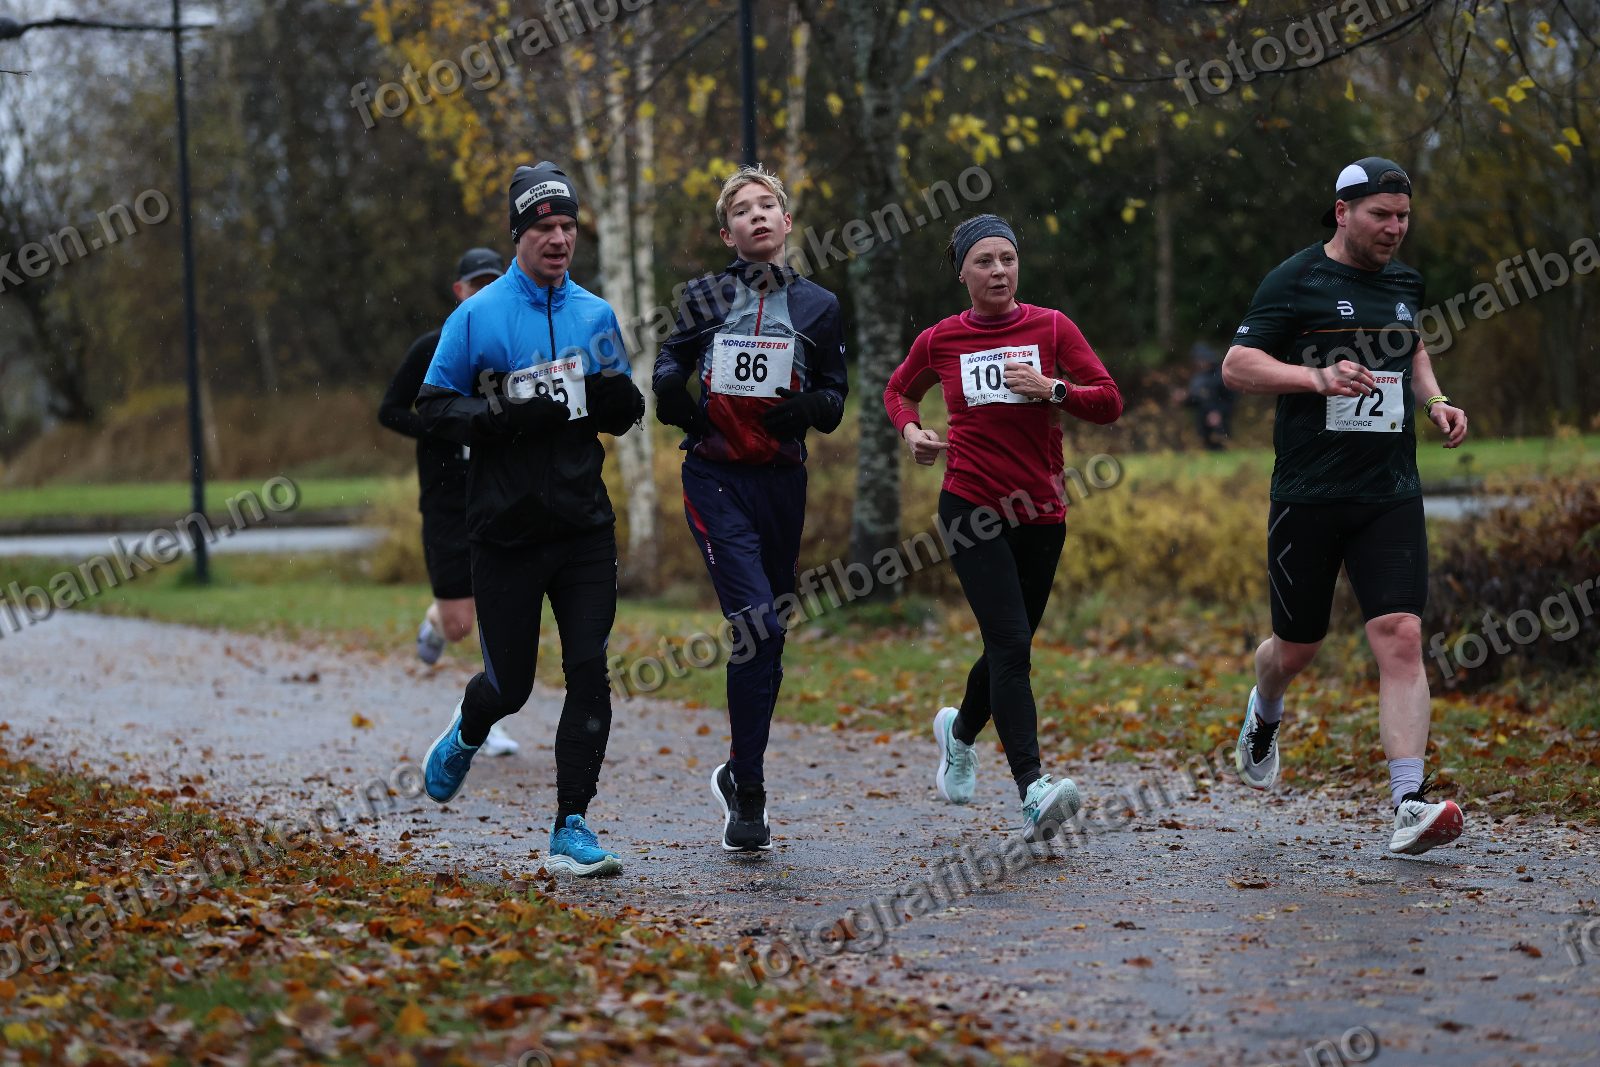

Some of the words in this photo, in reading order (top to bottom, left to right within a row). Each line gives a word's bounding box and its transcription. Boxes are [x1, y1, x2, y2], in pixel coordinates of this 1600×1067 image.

[529, 183, 548, 195] Oslo
[519, 188, 565, 210] Sportslager
[721, 340, 789, 350] NORGESTESTEN
[967, 350, 1034, 365] NORGESTESTEN
[513, 361, 577, 385] NORGESTESTEN
[734, 352, 768, 382] 86
